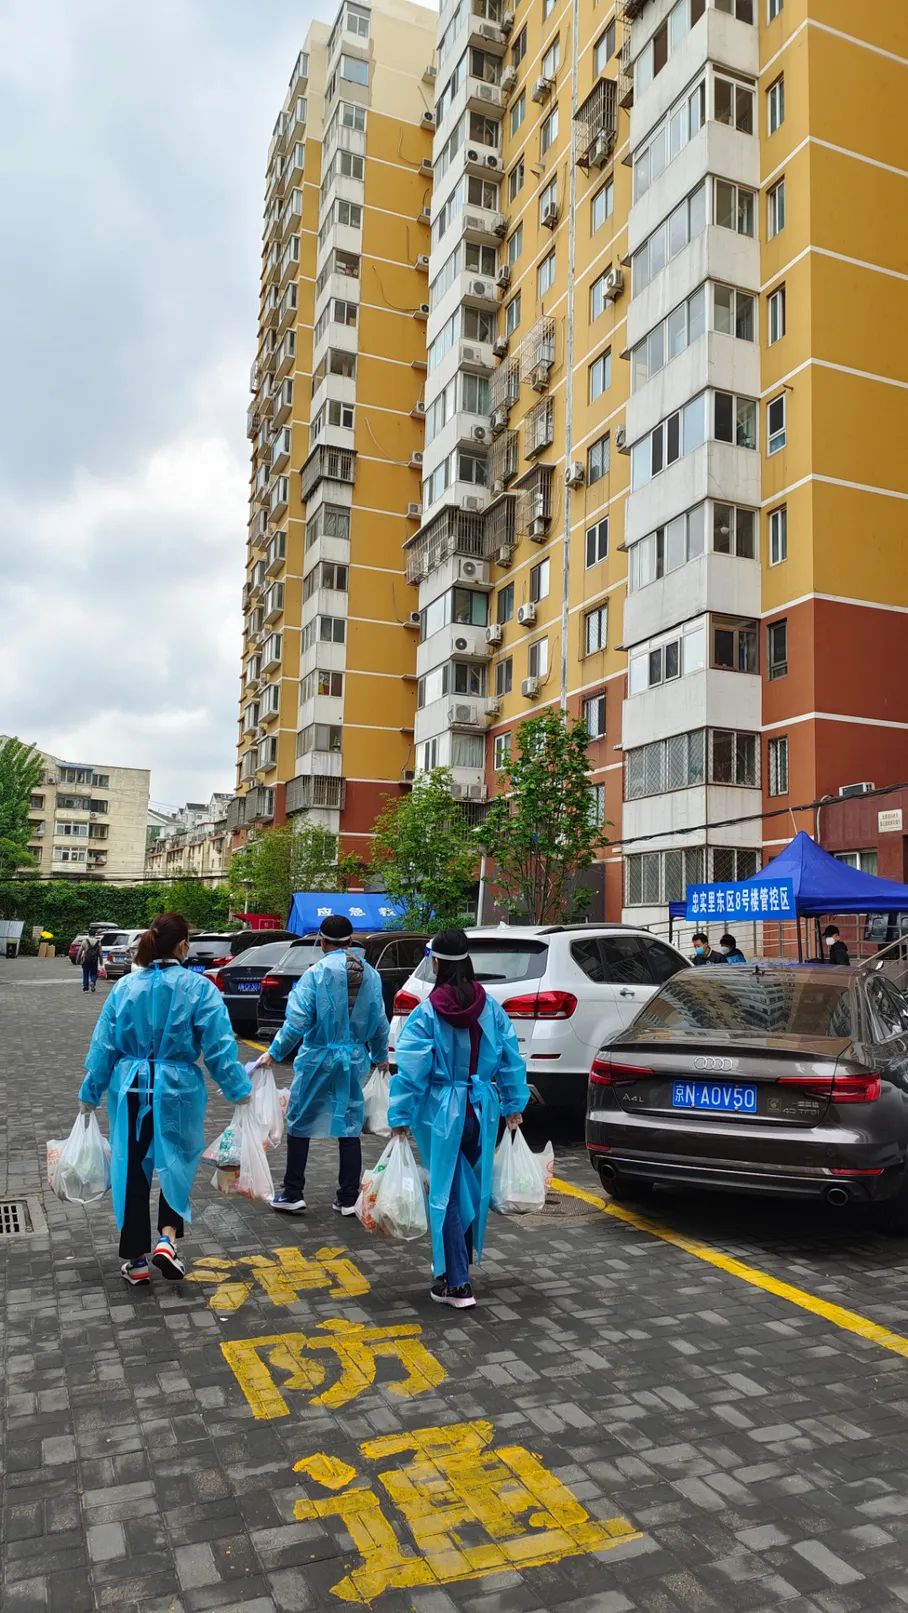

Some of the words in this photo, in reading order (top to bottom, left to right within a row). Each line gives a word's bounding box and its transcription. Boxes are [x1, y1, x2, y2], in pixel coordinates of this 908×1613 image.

[692, 887, 790, 913] 忠实里东区8号楼管控区
[317, 907, 397, 917] 应急救
